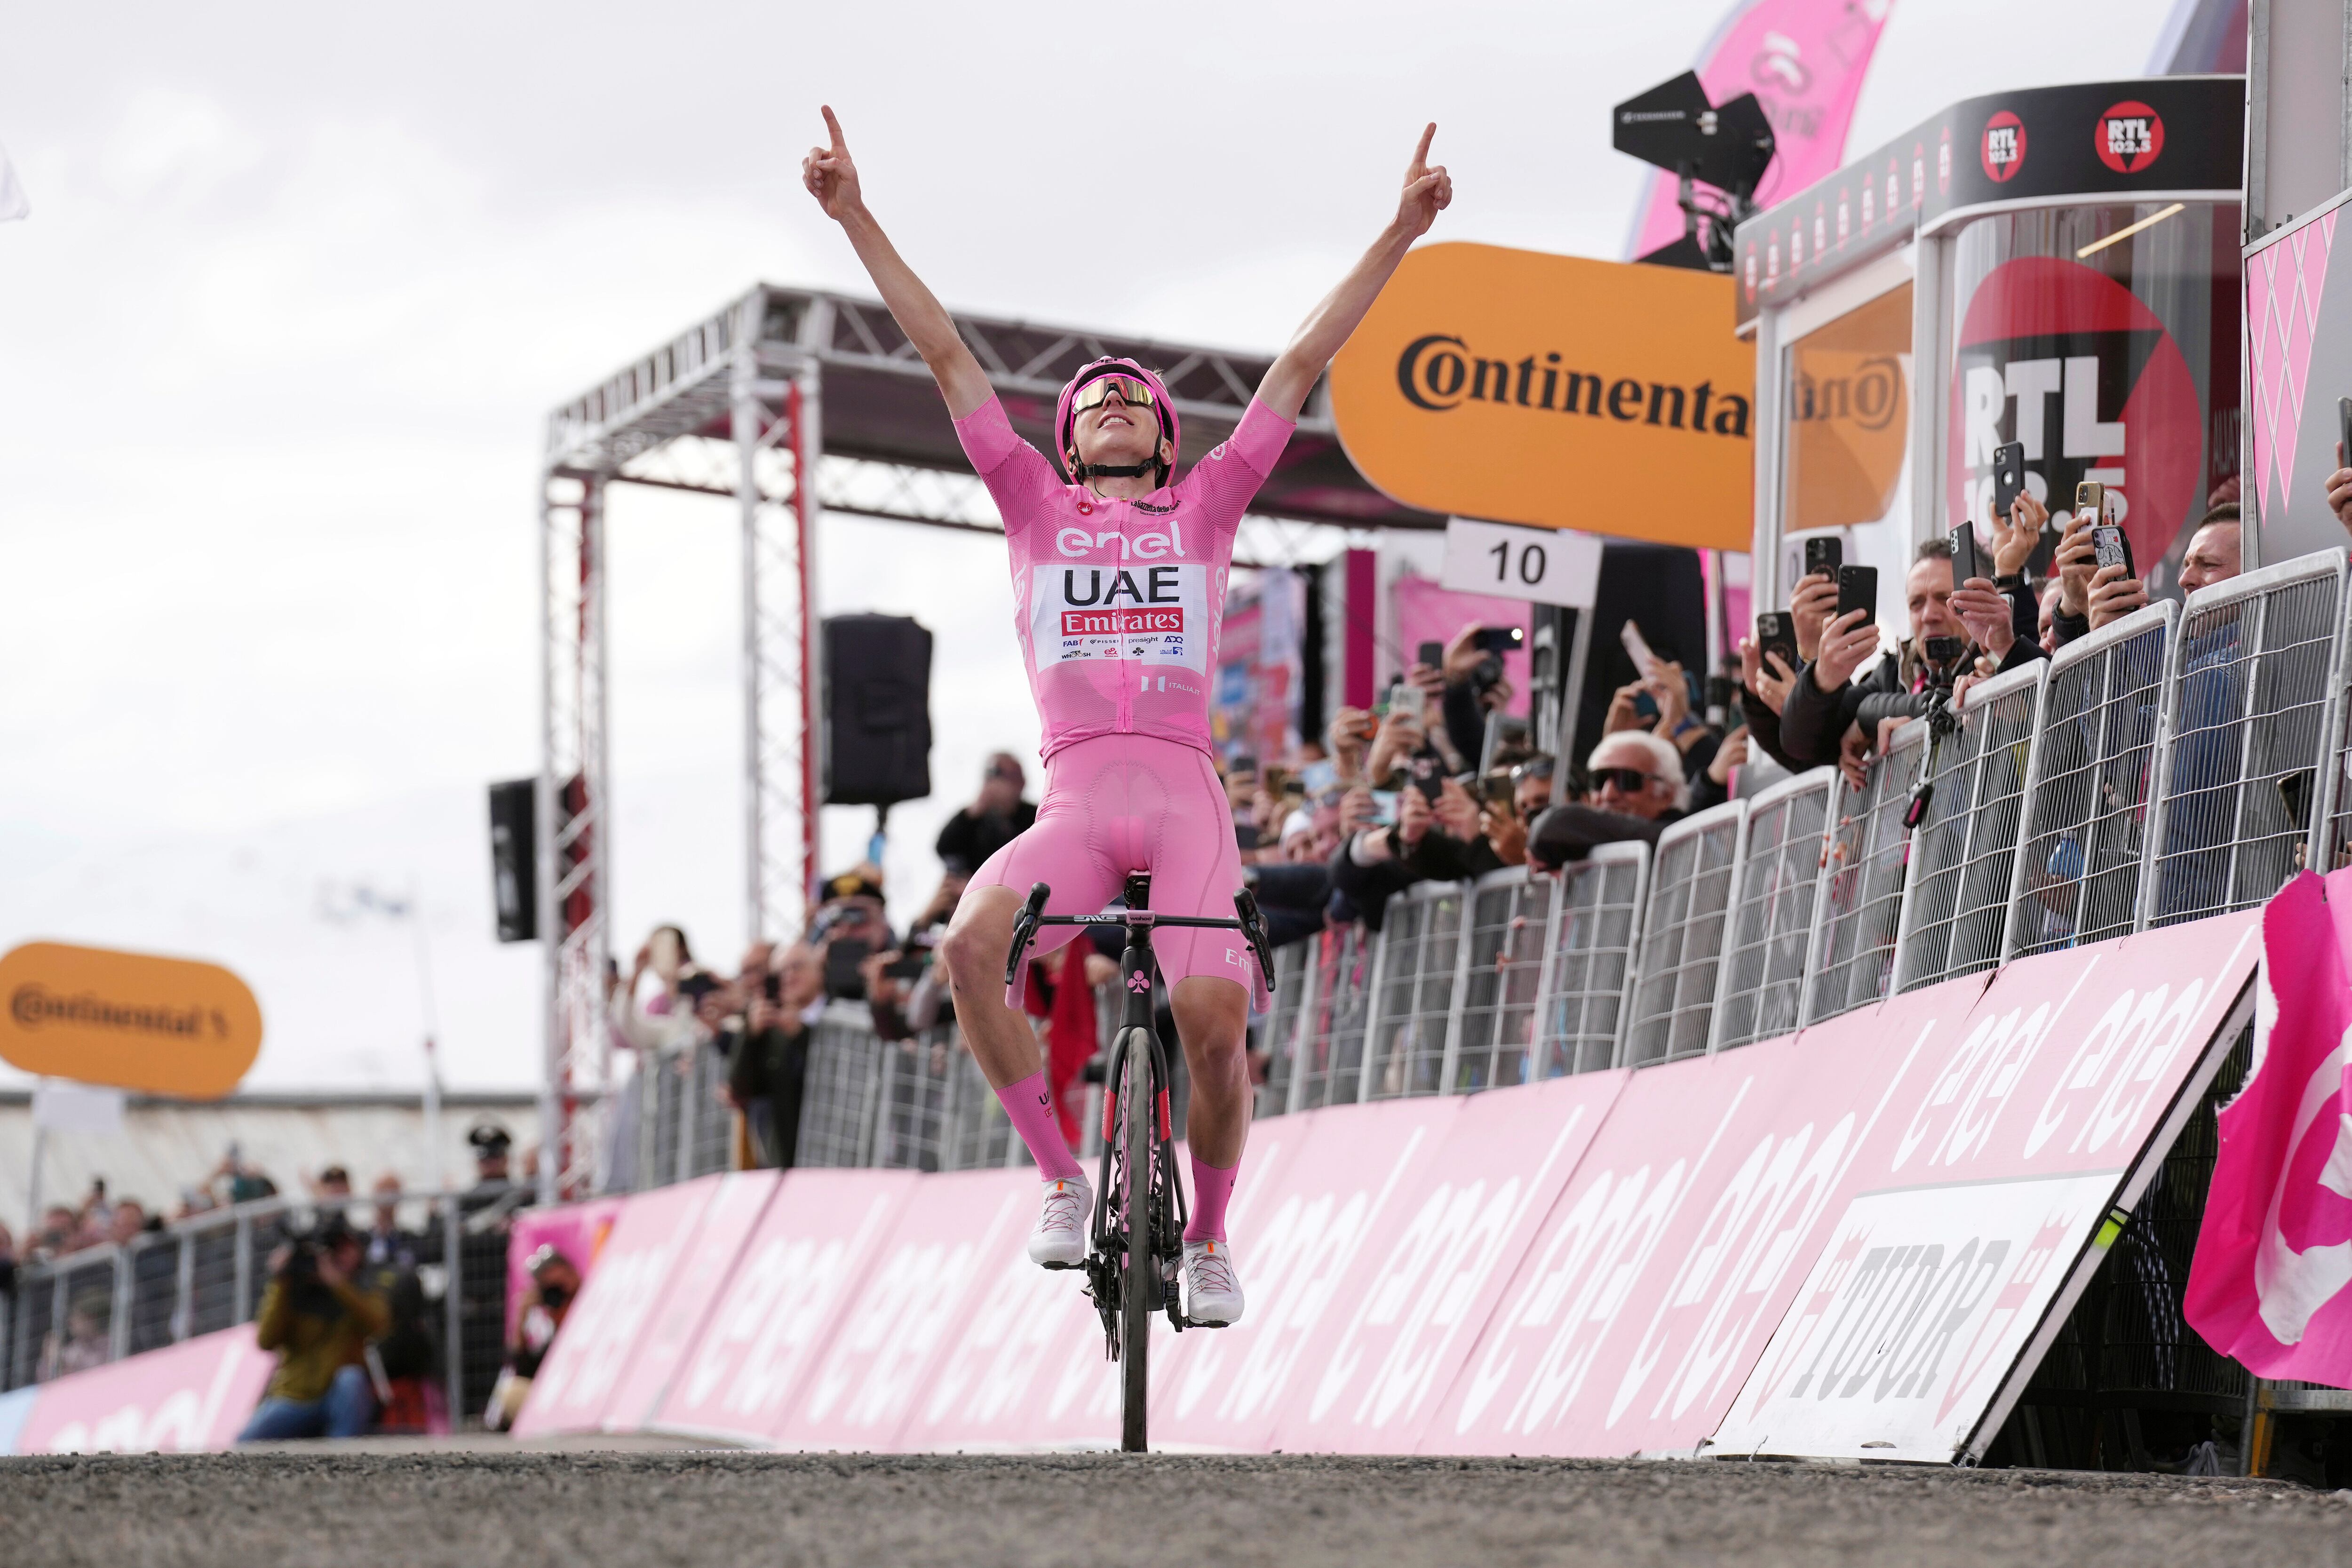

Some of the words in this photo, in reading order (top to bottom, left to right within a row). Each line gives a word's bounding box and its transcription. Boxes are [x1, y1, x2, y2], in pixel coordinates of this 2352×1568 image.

[1988, 128, 2017, 151] RTL
[2108, 119, 2151, 141] RTL
[2108, 141, 2151, 154] 102.5
[1988, 149, 2018, 164] 102.5
[1397, 333, 1754, 439] Continenta
[1965, 356, 2125, 469] RTL
[1137, 500, 1157, 512] Gazzetta
[1056, 521, 1186, 560] enel
[1489, 541, 1547, 585] 10
[1065, 567, 1180, 606] UAE
[1065, 612, 1180, 633] Emirates
[1169, 682, 1200, 696] ITALIA.IT
[1012, 927, 1028, 968] DURA-ACE
[2023, 924, 2258, 1160] enel
[1891, 954, 2102, 1173] enel
[1605, 1019, 1937, 1430] enel
[1309, 1103, 1585, 1430] enel
[1455, 1075, 1754, 1436] enel
[1789, 1236, 2011, 1404] TUDOR
